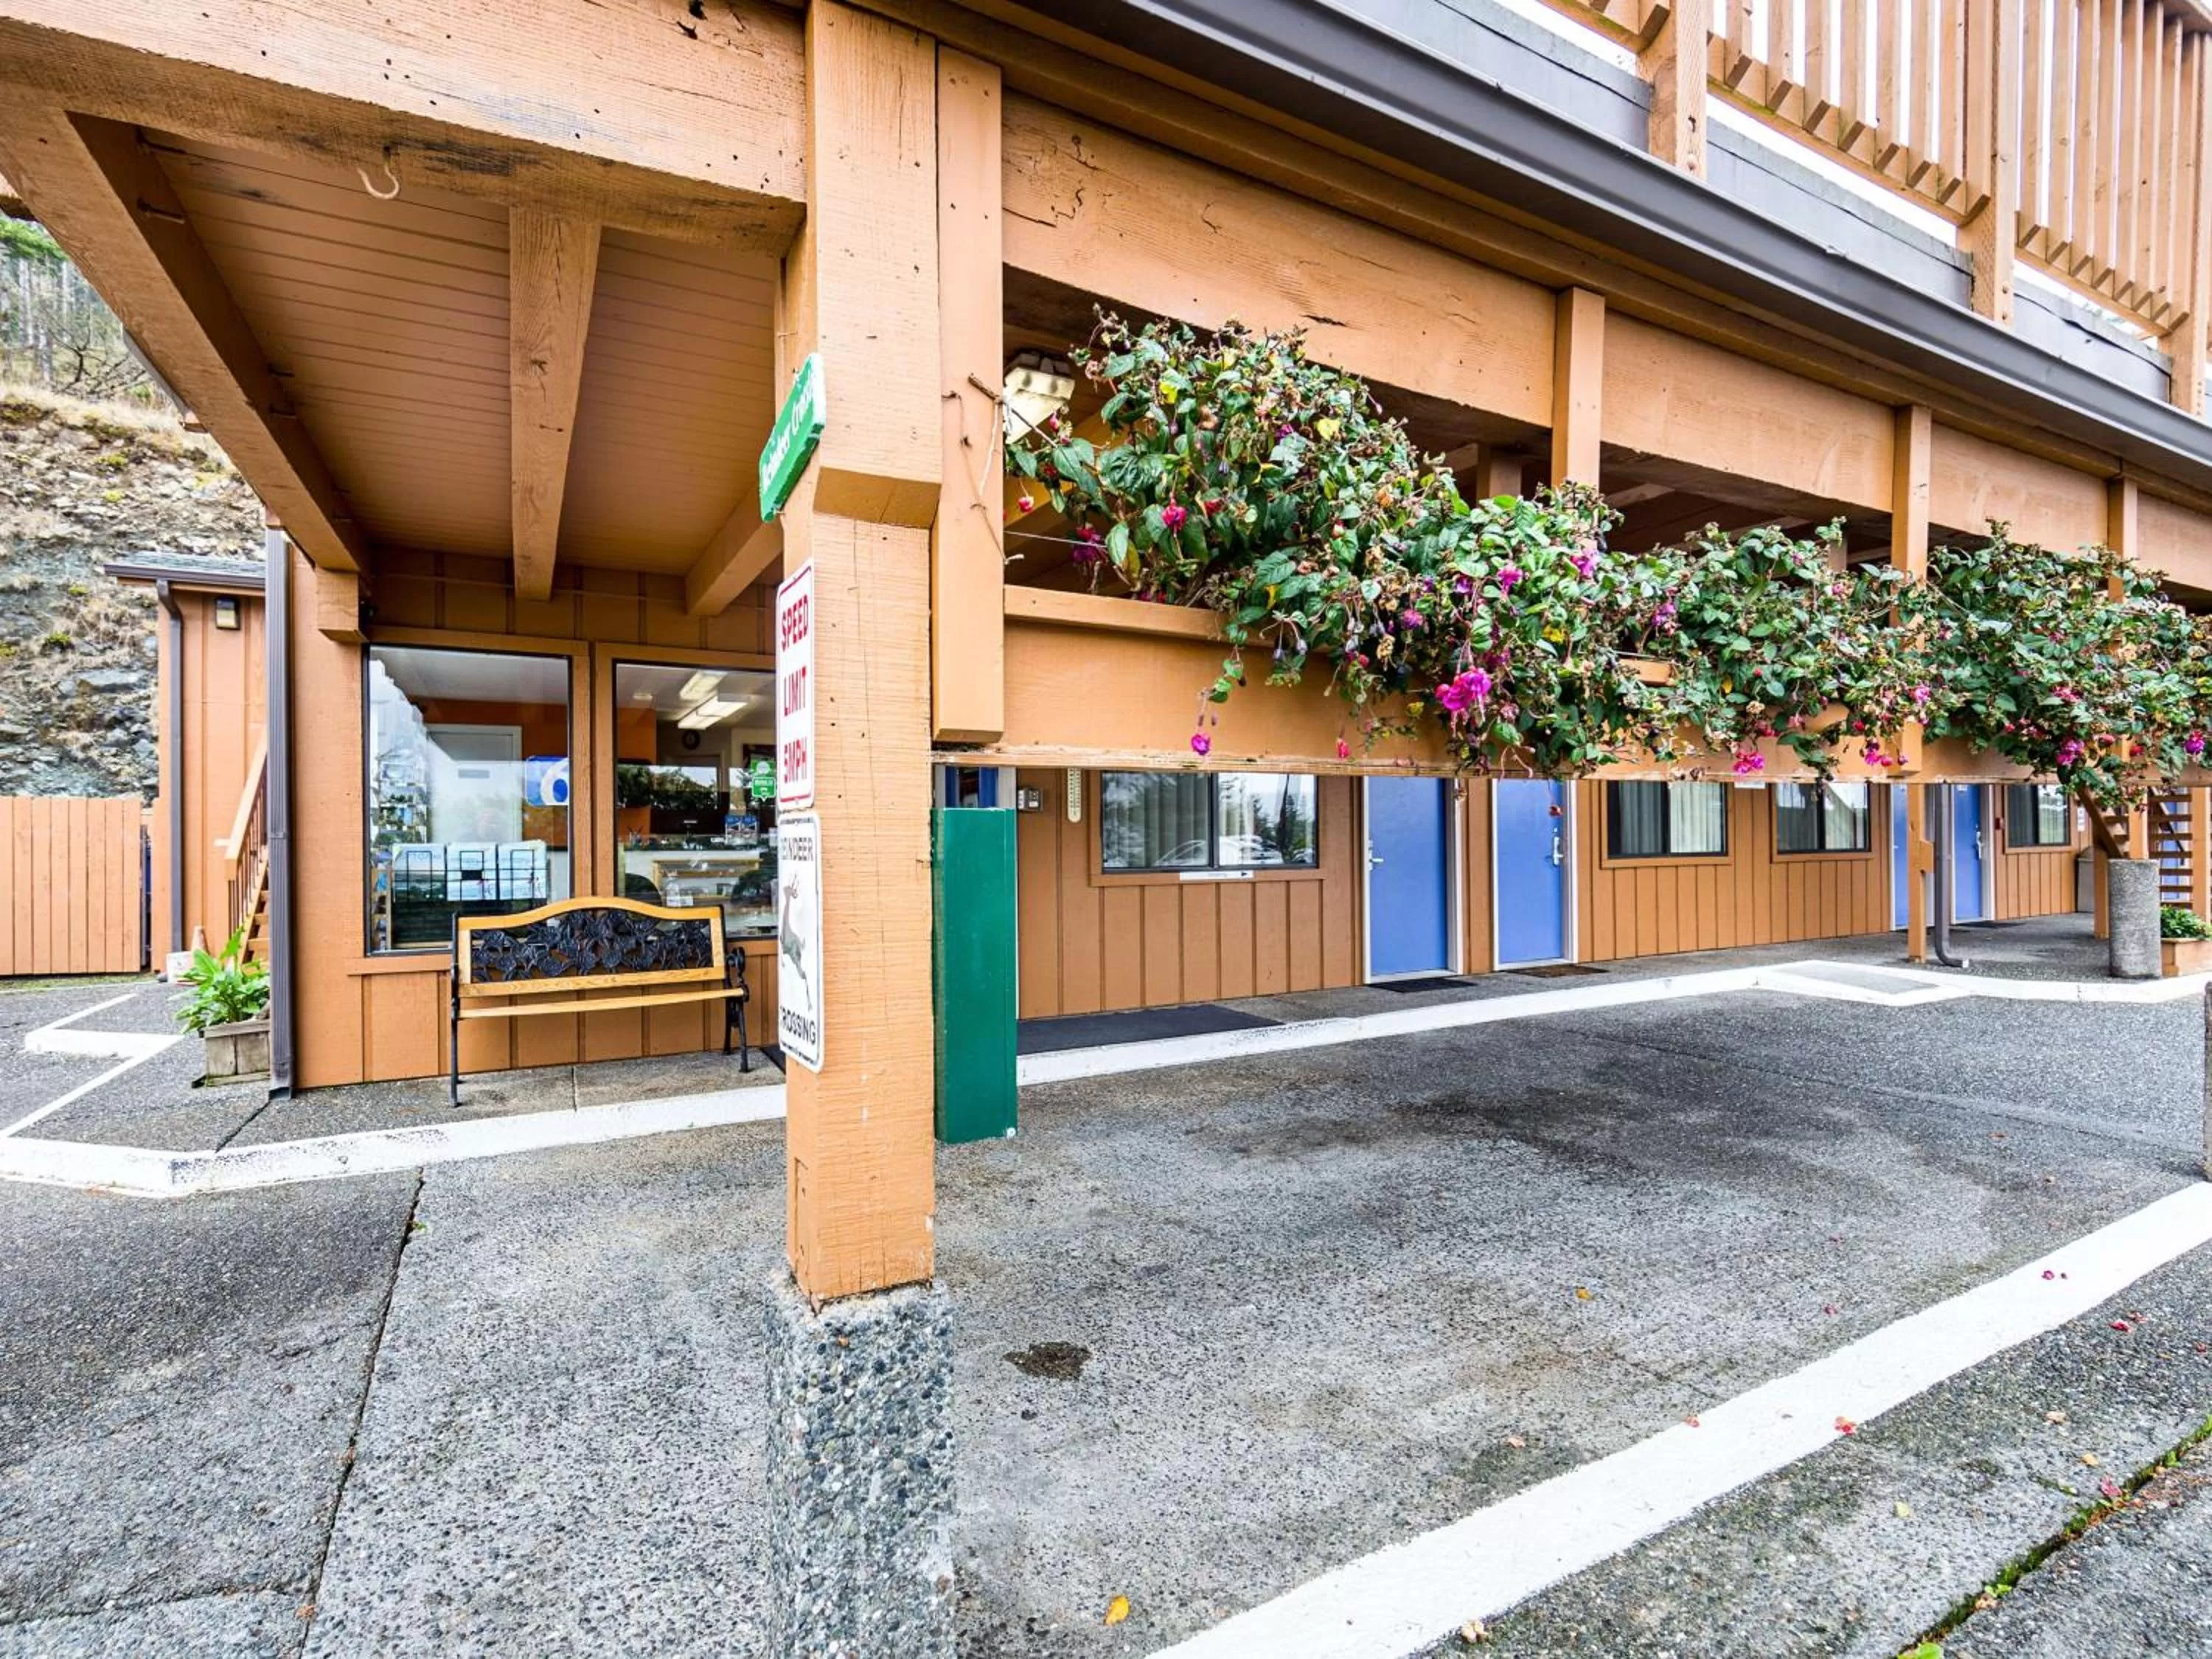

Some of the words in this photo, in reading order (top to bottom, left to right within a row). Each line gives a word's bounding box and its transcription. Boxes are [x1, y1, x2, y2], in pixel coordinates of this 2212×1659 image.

[782, 594, 808, 652] SPEED
[784, 666, 807, 717] LIMIT
[784, 737, 807, 784] 5MPH
[780, 1006, 816, 1045] ROSSING
